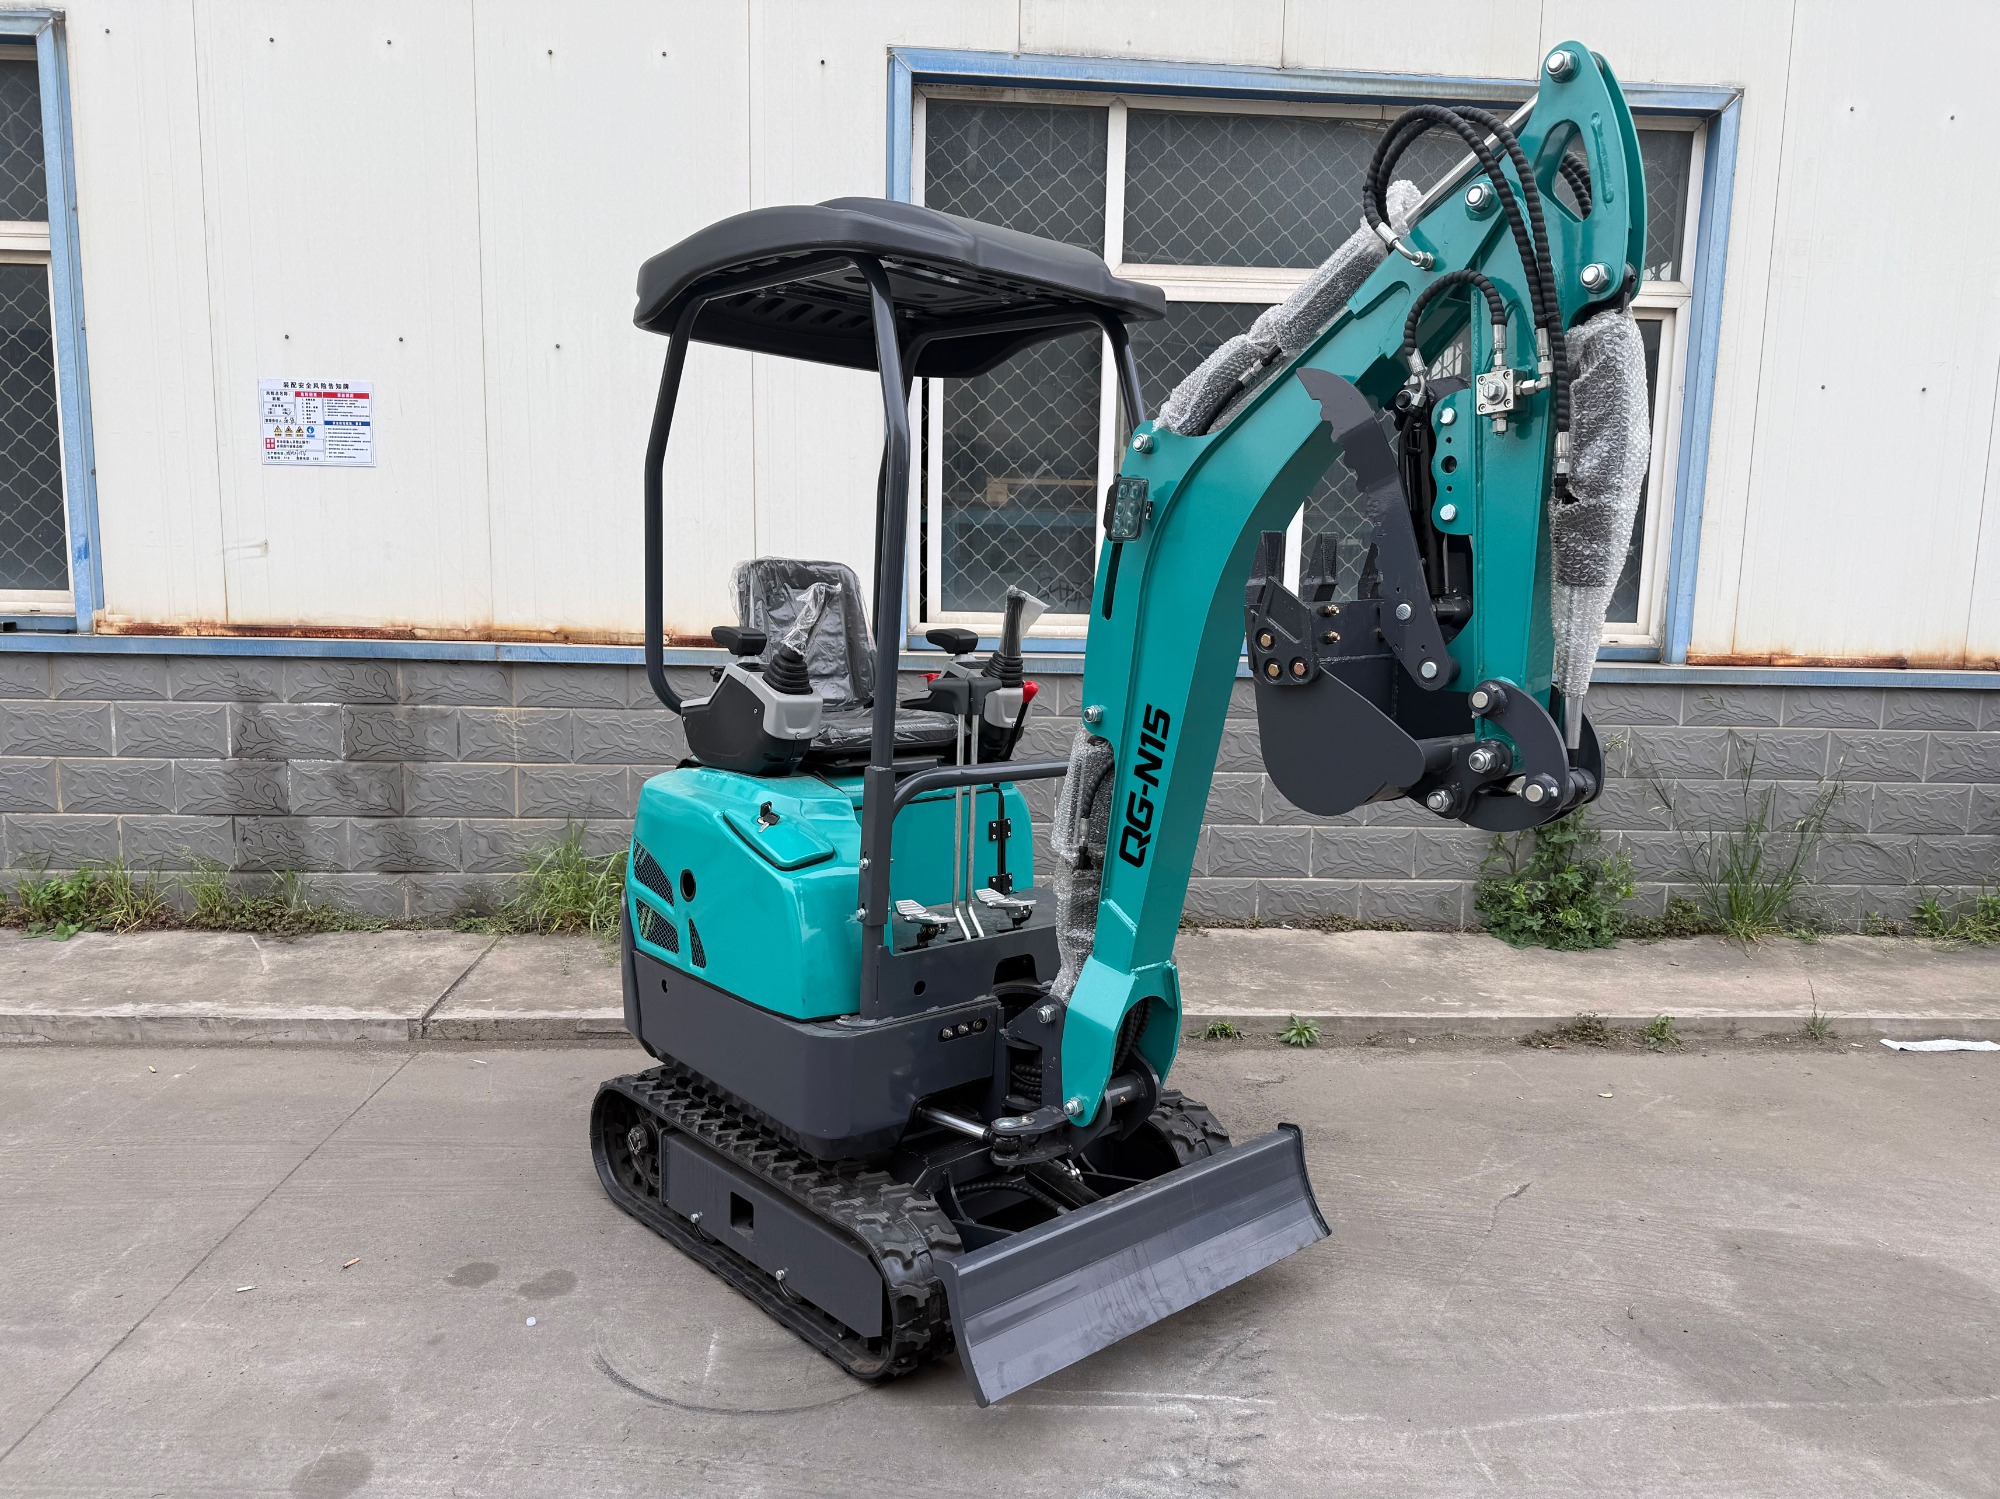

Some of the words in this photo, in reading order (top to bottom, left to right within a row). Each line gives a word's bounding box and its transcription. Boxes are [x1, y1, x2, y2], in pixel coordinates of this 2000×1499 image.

[283, 381, 350, 390] 装配安全风险告知牌
[1119, 703, 1171, 868] QG-N15
